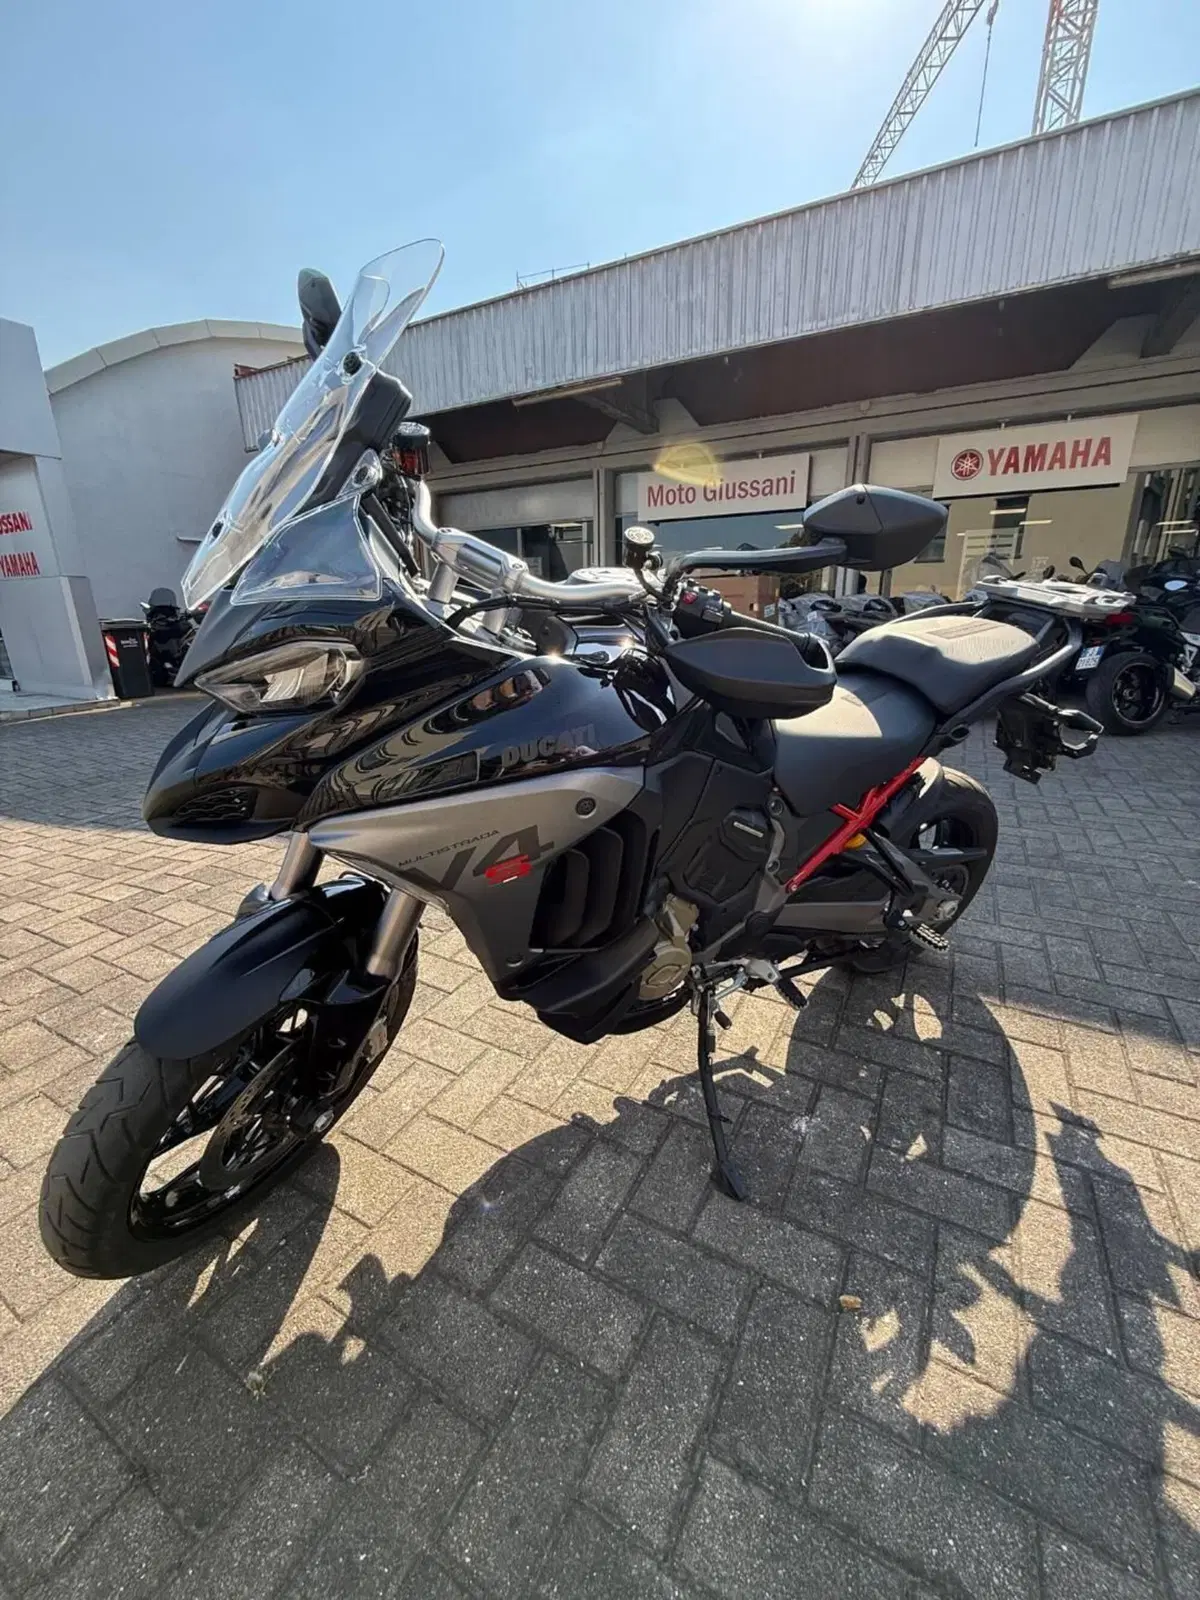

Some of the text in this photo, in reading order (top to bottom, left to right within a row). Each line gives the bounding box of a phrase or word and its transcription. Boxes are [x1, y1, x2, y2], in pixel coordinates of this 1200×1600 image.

[987, 436, 1111, 476] YAMAHA
[647, 470, 796, 507] Moto Giussani
[501, 723, 595, 768] DUCATI
[398, 829, 500, 867] MULTISTRADA
